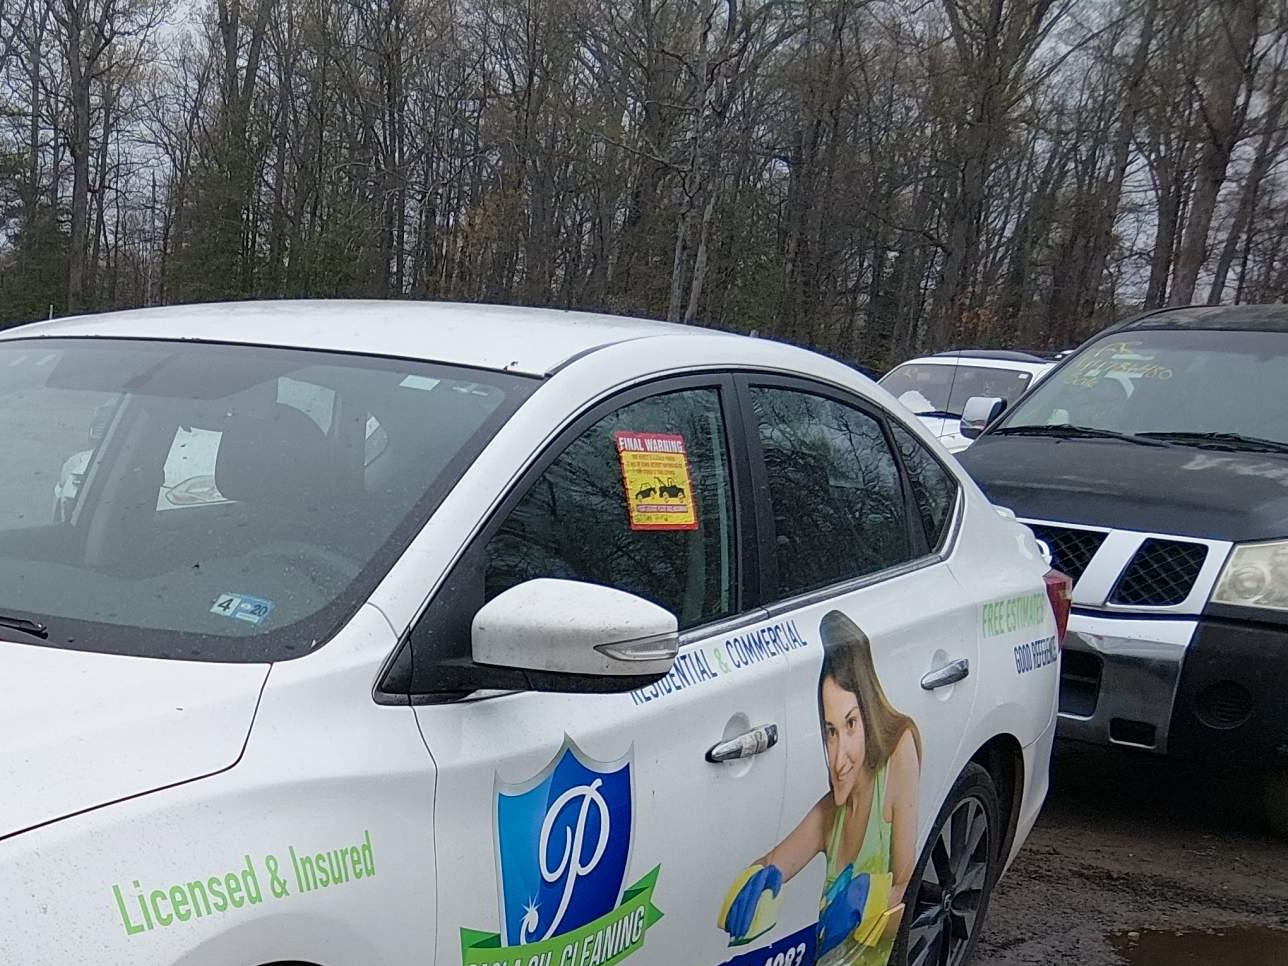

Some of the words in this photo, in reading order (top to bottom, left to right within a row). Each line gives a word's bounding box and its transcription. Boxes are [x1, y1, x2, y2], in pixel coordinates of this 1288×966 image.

[618, 437, 644, 451] FINAL
[645, 438, 683, 453] WARNING
[217, 598, 234, 612] 4
[983, 601, 1005, 639] FREE
[713, 647, 732, 673] &
[725, 619, 808, 669] COMMERCIAL
[112, 854, 263, 936] Licensed
[265, 854, 290, 899] &
[289, 830, 377, 893] Insured
